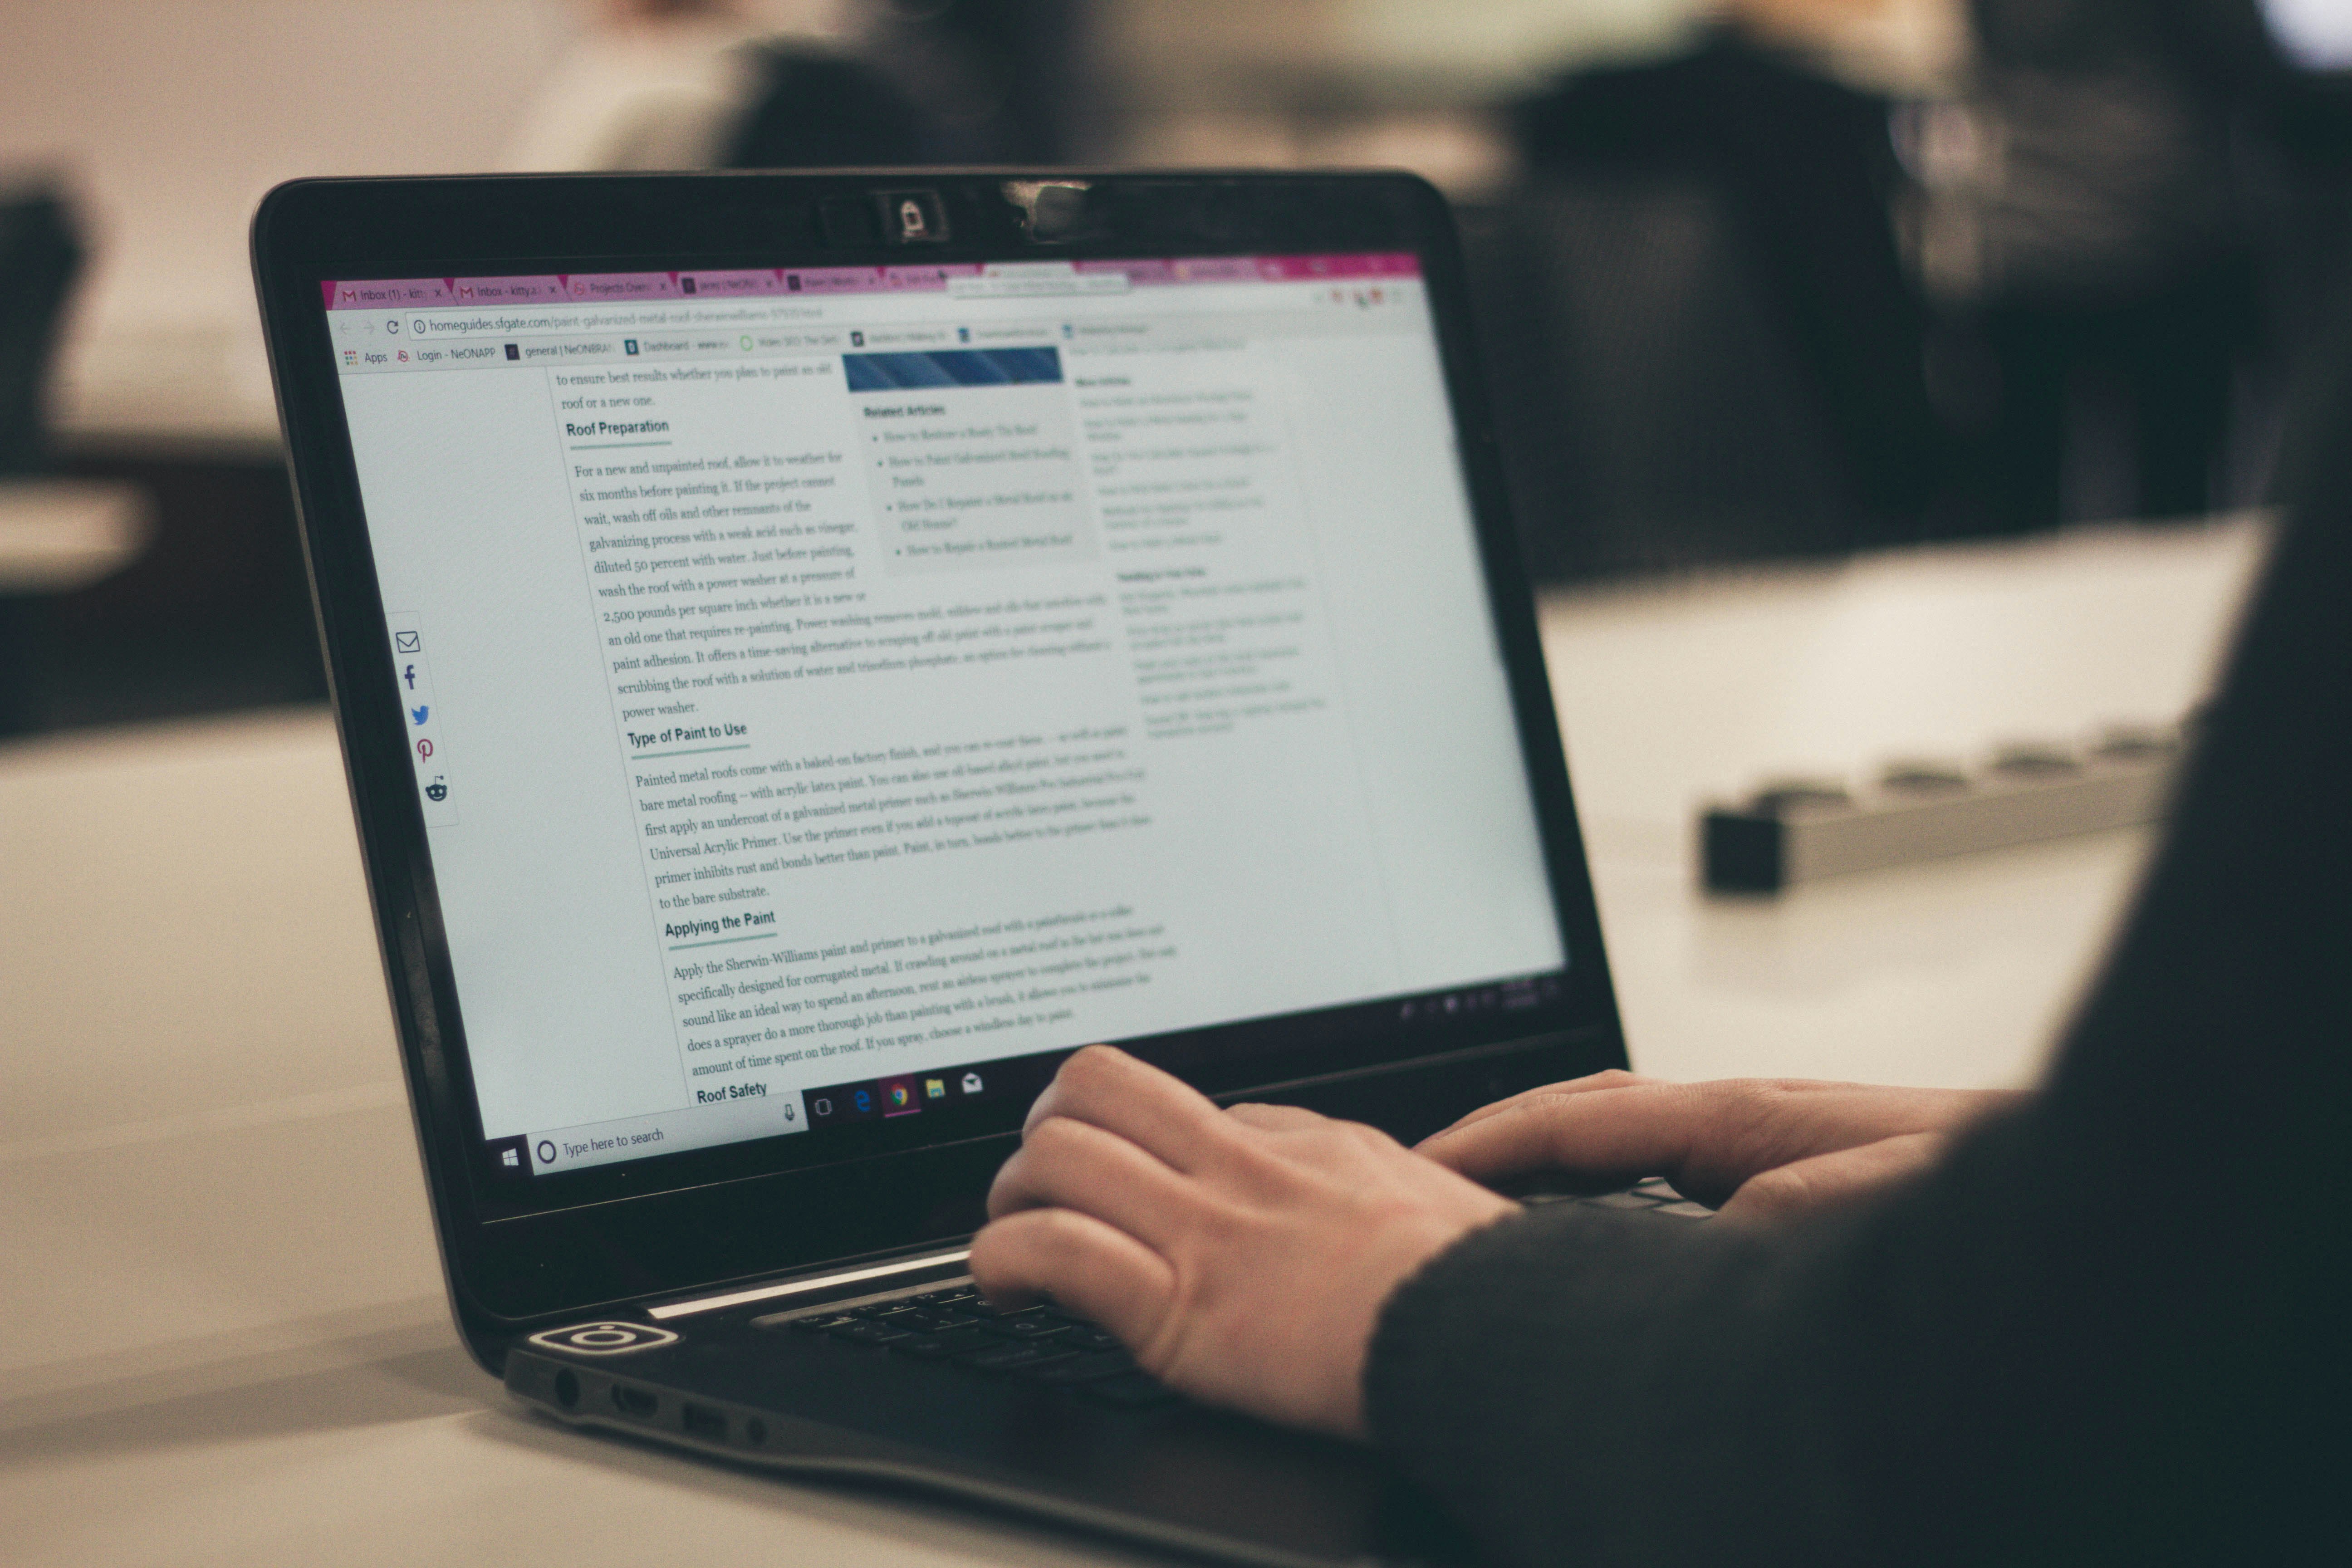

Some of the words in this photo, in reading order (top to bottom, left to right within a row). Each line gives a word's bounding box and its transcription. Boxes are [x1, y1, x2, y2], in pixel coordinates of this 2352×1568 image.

[360, 289, 387, 301] Inbox
[387, 289, 402, 301] (1)
[408, 288, 424, 299] kitt
[476, 286, 503, 297] Inbox
[364, 352, 388, 365] Apps
[416, 350, 443, 363] Login
[450, 347, 496, 359] NeONAPP
[524, 345, 558, 359] general
[555, 374, 569, 386] to
[569, 374, 606, 386] ensure
[607, 371, 631, 383] best
[632, 368, 668, 383] results
[560, 396, 584, 410] roof
[585, 399, 598, 409] or
[608, 397, 631, 408] new
[632, 396, 656, 407] one.
[565, 422, 596, 436] Roof
[598, 420, 670, 437] Preparation
[573, 465, 594, 478] For
[604, 466, 627, 476] new
[629, 461, 650, 475] and
[651, 457, 706, 476] unpainted
[579, 488, 596, 502] six
[596, 485, 638, 501] months
[638, 485, 673, 498] before
[583, 512, 611, 525] wait,
[612, 510, 641, 524] wash
[642, 508, 657, 522] off
[658, 507, 679, 521] oils
[679, 505, 701, 519] and
[588, 534, 651, 553] galvanizing
[651, 534, 691, 549] process
[692, 529, 717, 543] with
[593, 558, 632, 574] diluted
[633, 560, 649, 573] 50
[649, 556, 690, 573] percent
[691, 553, 716, 567] with
[598, 583, 627, 598] wash
[627, 583, 646, 596] the
[647, 580, 670, 595] roof
[671, 578, 696, 592] with
[603, 610, 636, 624] 2,500
[636, 604, 677, 623] pounds
[677, 606, 696, 620] per
[697, 603, 734, 617] square
[608, 636, 623, 647] an
[623, 630, 642, 645] old
[642, 632, 664, 643] one
[664, 628, 687, 642] that
[688, 625, 733, 642] requires
[612, 657, 641, 674] paint
[642, 652, 694, 668] adhesion.
[695, 650, 706, 663] It
[707, 648, 738, 662] offers
[617, 678, 672, 695] scrubbing
[671, 676, 690, 690] the
[691, 673, 714, 688] roof
[714, 671, 740, 685] with
[621, 707, 656, 722] power
[657, 701, 696, 715] washer.
[627, 732, 657, 749] Type
[659, 728, 672, 743] of
[674, 726, 707, 741] Paint
[708, 725, 722, 738] to
[723, 723, 747, 737] Use
[634, 770, 677, 788] Painted
[678, 767, 710, 784] metal
[710, 764, 739, 780] roofs
[739, 765, 768, 777] come
[638, 799, 665, 812] bare
[666, 793, 698, 809] metal
[698, 790, 738, 806] roofing
[750, 785, 774, 799] with
[644, 823, 667, 837] first
[669, 818, 698, 837] apply
[701, 819, 715, 830] an
[715, 812, 769, 828] undercoat
[649, 842, 701, 861] Universal
[703, 838, 739, 856] Acrylic
[740, 836, 778, 850] Primer.
[654, 871, 692, 889] primer
[693, 864, 735, 881] inhibits
[735, 862, 758, 876] rust
[759, 858, 780, 872] and
[658, 898, 671, 910] to
[671, 894, 691, 908] the
[691, 892, 716, 906] bare
[717, 886, 770, 902] substrate.
[665, 920, 720, 939] Applying
[721, 916, 741, 930] the
[743, 911, 776, 926] Paint
[673, 962, 704, 981] Apply
[705, 960, 724, 974] the
[677, 983, 735, 1006] specifically
[737, 975, 785, 995] designed
[785, 974, 802, 988] for
[682, 1010, 716, 1028] sound
[715, 1008, 737, 1023] like
[738, 1009, 753, 1019] an
[754, 1000, 781, 1017] ideal
[781, 1001, 802, 1014] way
[686, 1038, 713, 1052] does
[722, 1032, 763, 1049] sprayer
[763, 1027, 779, 1041] do
[788, 1024, 816, 1038] more
[691, 1060, 734, 1077] amount
[735, 1055, 747, 1070] of
[747, 1054, 773, 1068] time
[774, 1049, 804, 1067] spent
[696, 1086, 727, 1104] Roof
[728, 1082, 767, 1099] Safety
[563, 1142, 589, 1158] Type
[590, 1138, 615, 1152] here
[615, 1136, 629, 1147] to
[630, 1127, 665, 1146] search
